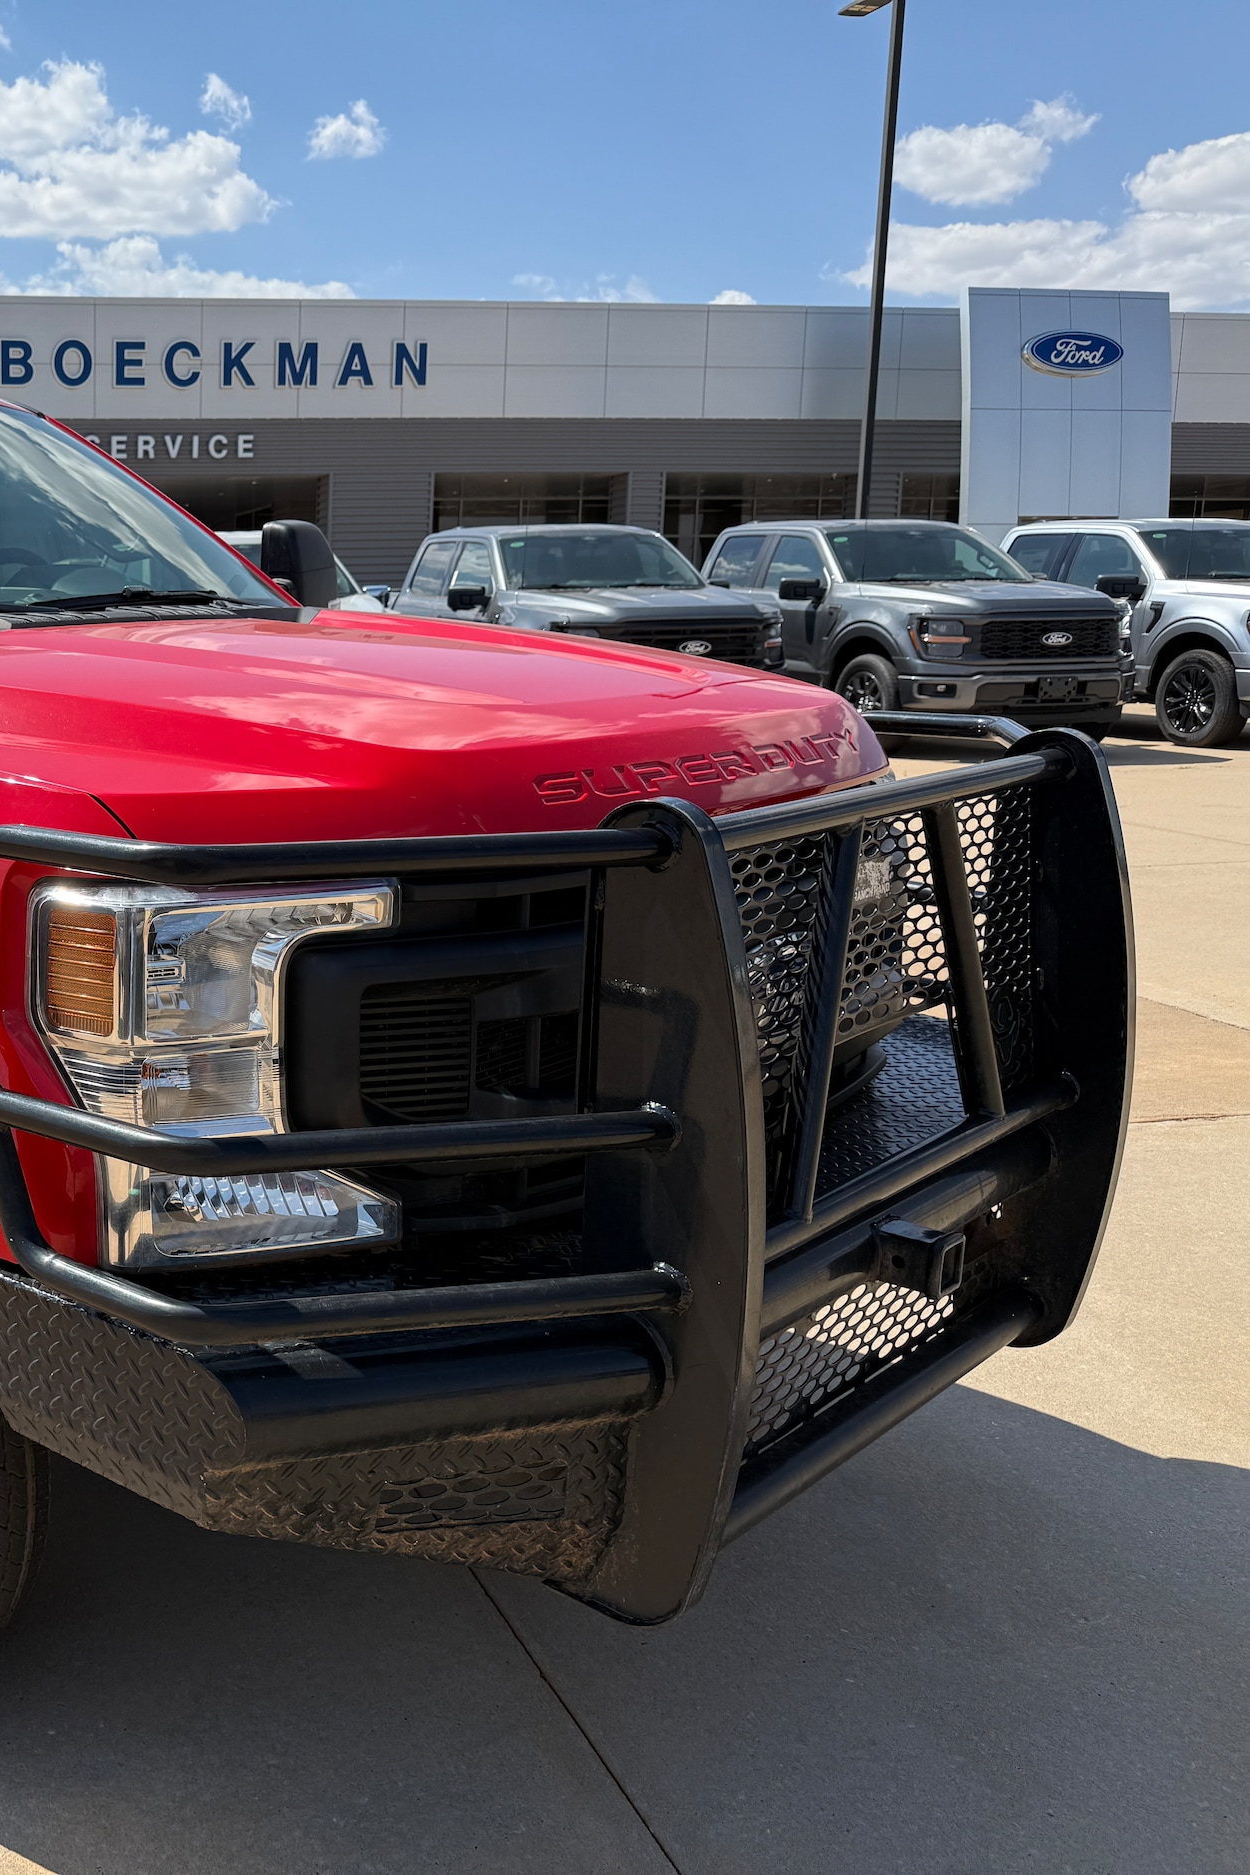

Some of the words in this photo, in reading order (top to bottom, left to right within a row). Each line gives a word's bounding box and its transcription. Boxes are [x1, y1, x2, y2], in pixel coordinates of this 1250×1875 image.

[0, 338, 429, 388] BOECKMAN
[1051, 339, 1105, 364] Ford
[532, 750, 758, 806] SUPER
[754, 728, 860, 772] DUTY
